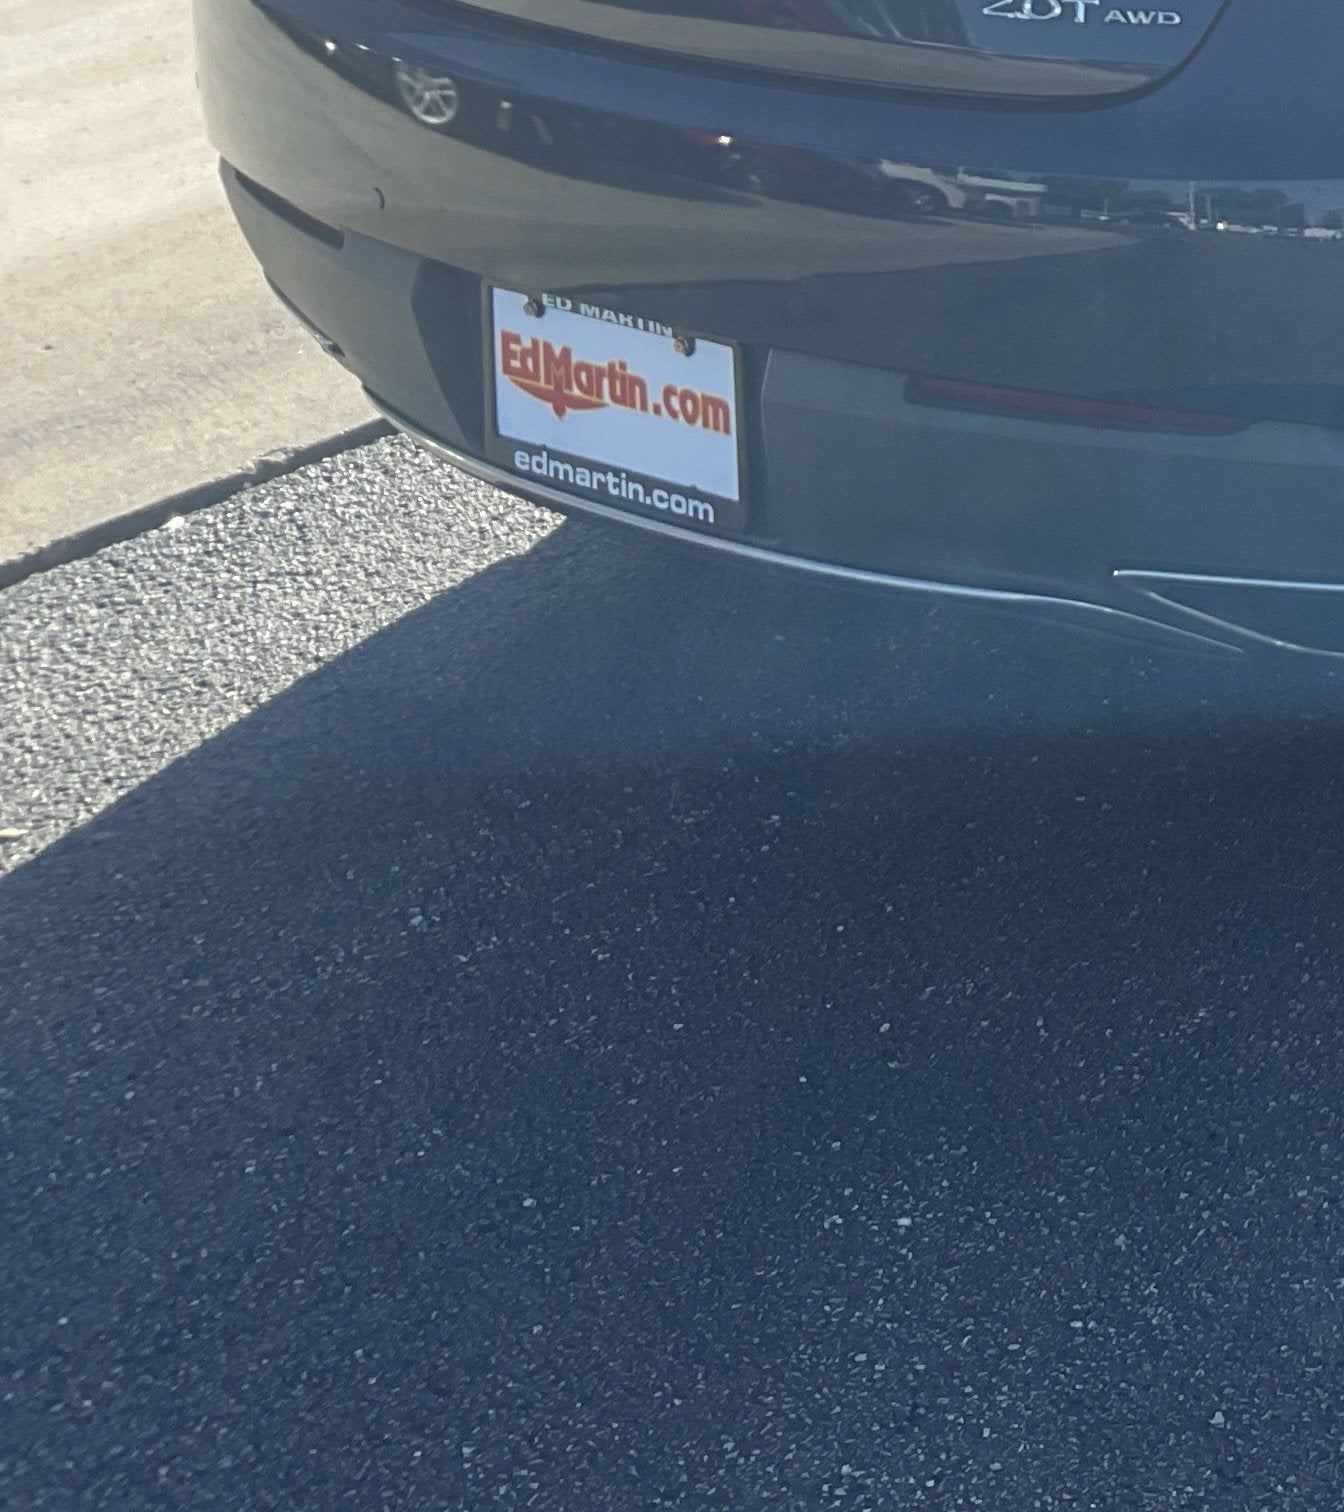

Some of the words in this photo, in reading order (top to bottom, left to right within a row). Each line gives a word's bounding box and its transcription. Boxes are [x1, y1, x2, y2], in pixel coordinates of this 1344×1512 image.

[1103, 9, 1182, 25] AWD
[500, 328, 732, 436] EdMartin.com
[514, 449, 715, 524] edmartin.com
